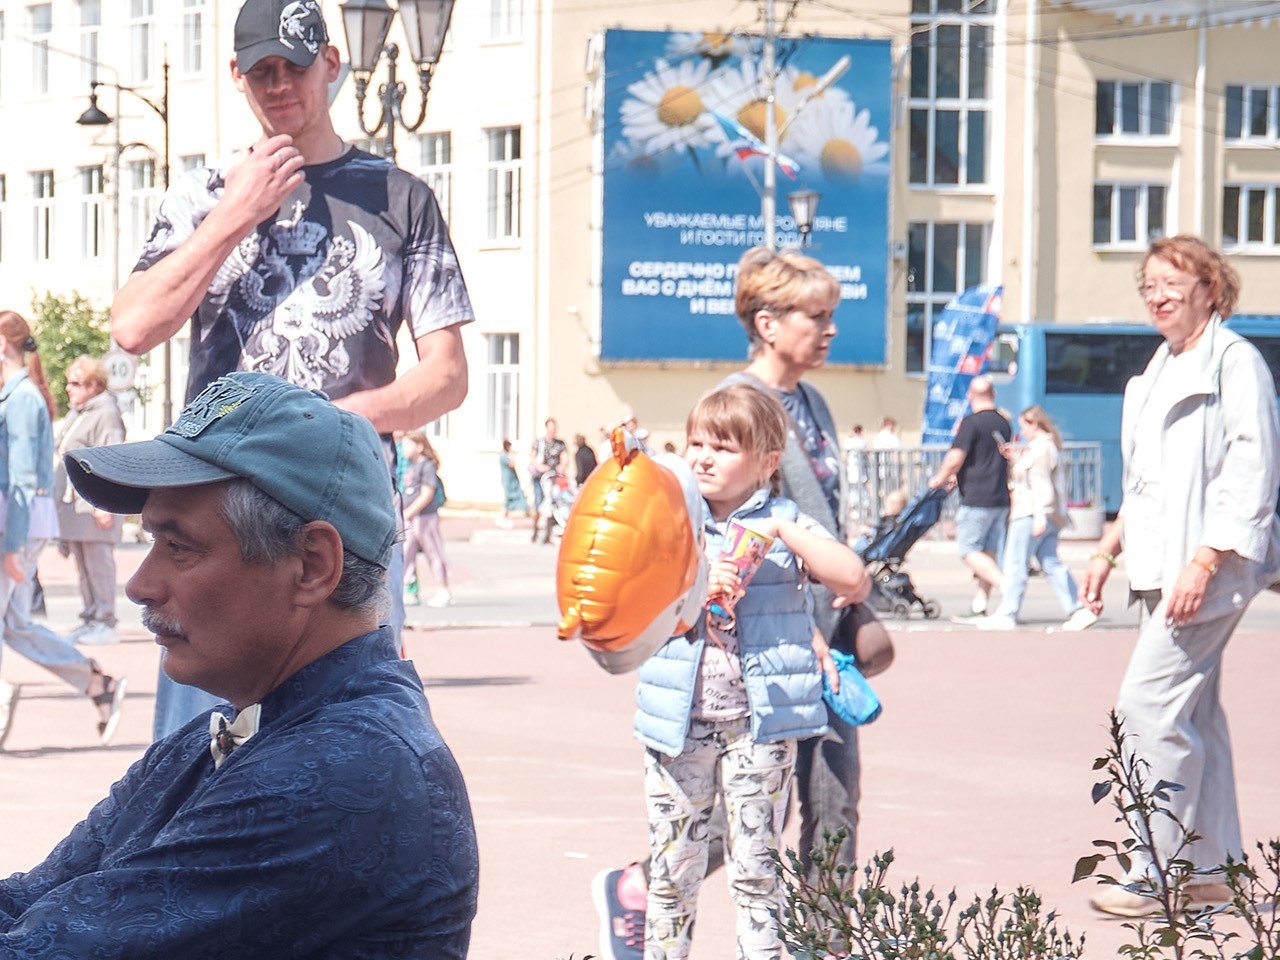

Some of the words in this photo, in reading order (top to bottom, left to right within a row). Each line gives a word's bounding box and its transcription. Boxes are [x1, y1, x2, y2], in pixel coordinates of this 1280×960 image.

[643, 212, 747, 230] УВАЖАЕМЫЕ
[680, 230, 694, 245] И
[695, 230, 746, 246] ГОСТИ
[629, 261, 725, 280] СЕРДЕЧНО
[622, 278, 660, 296] ВАС
[661, 280, 676, 296] С
[676, 277, 731, 298] ДНЁМ
[690, 298, 705, 314] И
